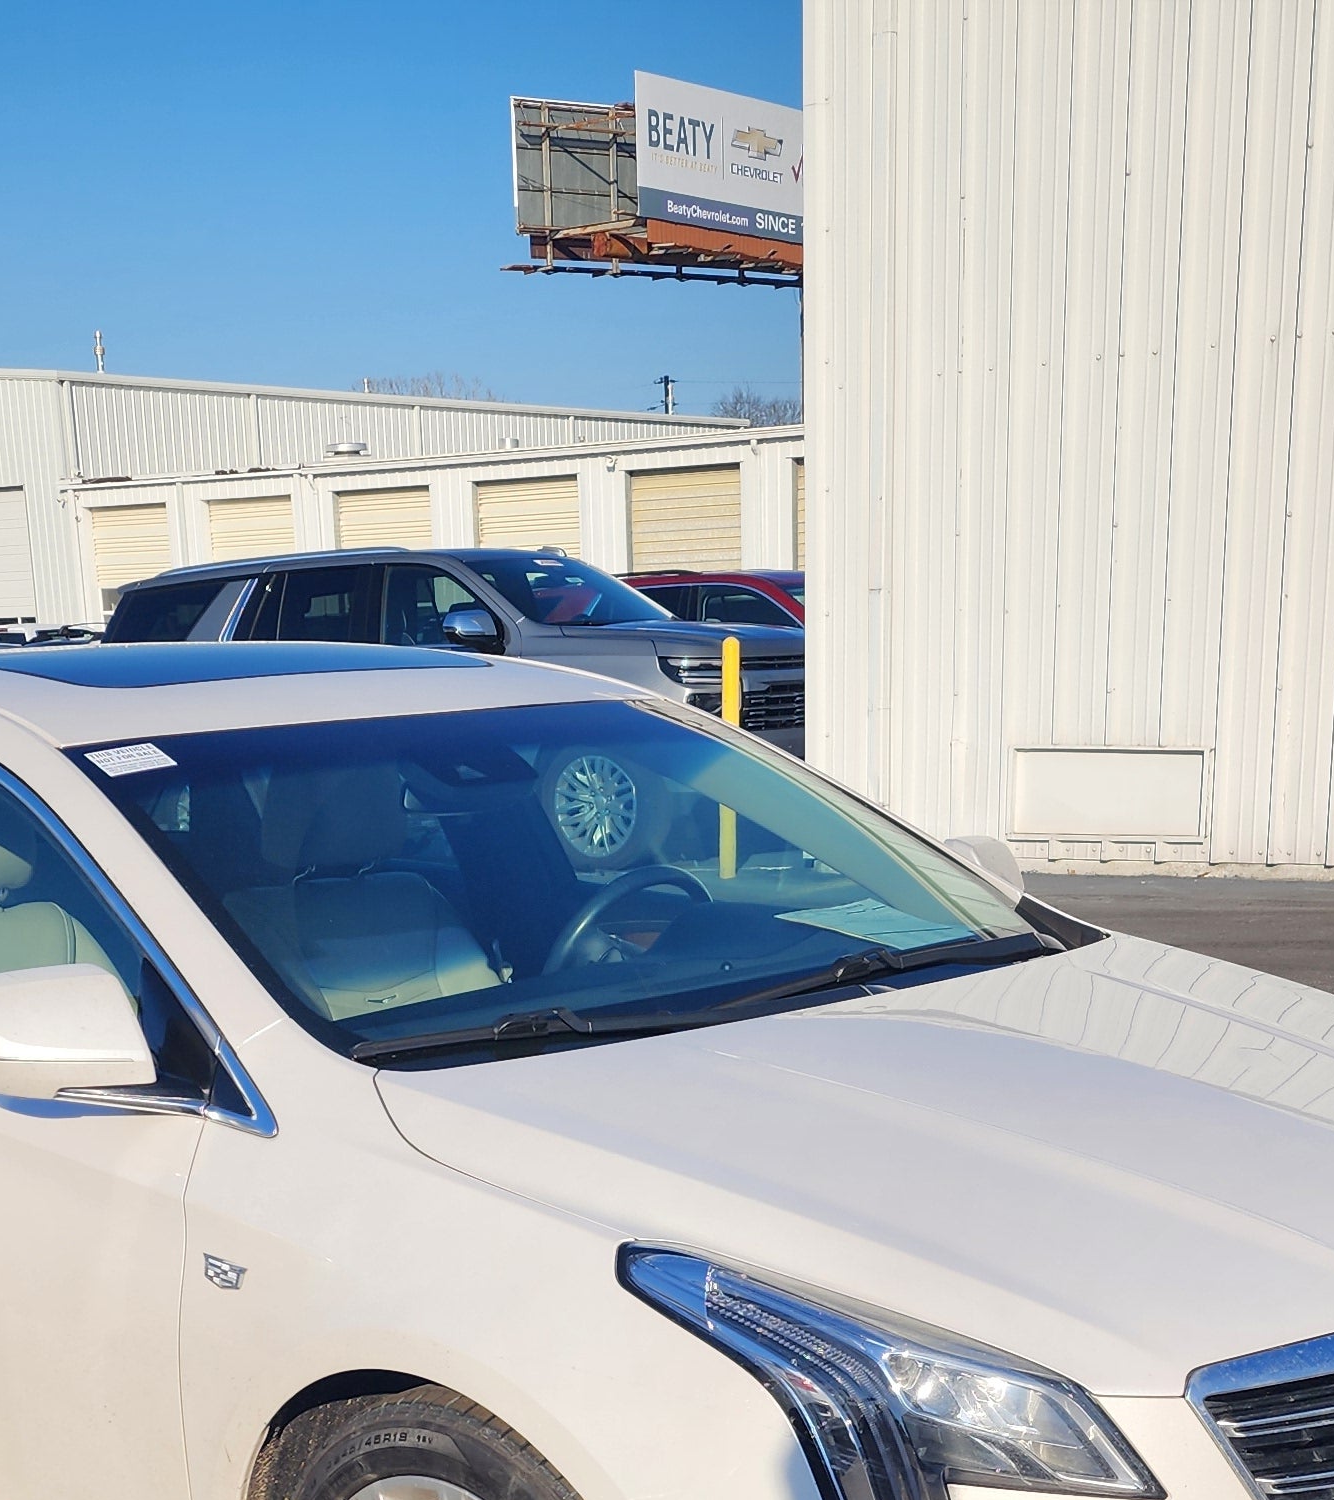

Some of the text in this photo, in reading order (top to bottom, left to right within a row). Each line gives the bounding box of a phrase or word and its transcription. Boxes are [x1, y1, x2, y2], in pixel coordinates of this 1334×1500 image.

[647, 108, 715, 160] BEATY
[651, 152, 718, 174] IT'S BETTER AT BEATY
[730, 163, 783, 184] CHEVROLET
[667, 200, 749, 228] BeatyChevrolet.com
[755, 212, 797, 235] SINCE
[88, 744, 154, 760] THIS VEHICLE
[116, 753, 137, 761] FOR
[135, 749, 161, 757] SALE
